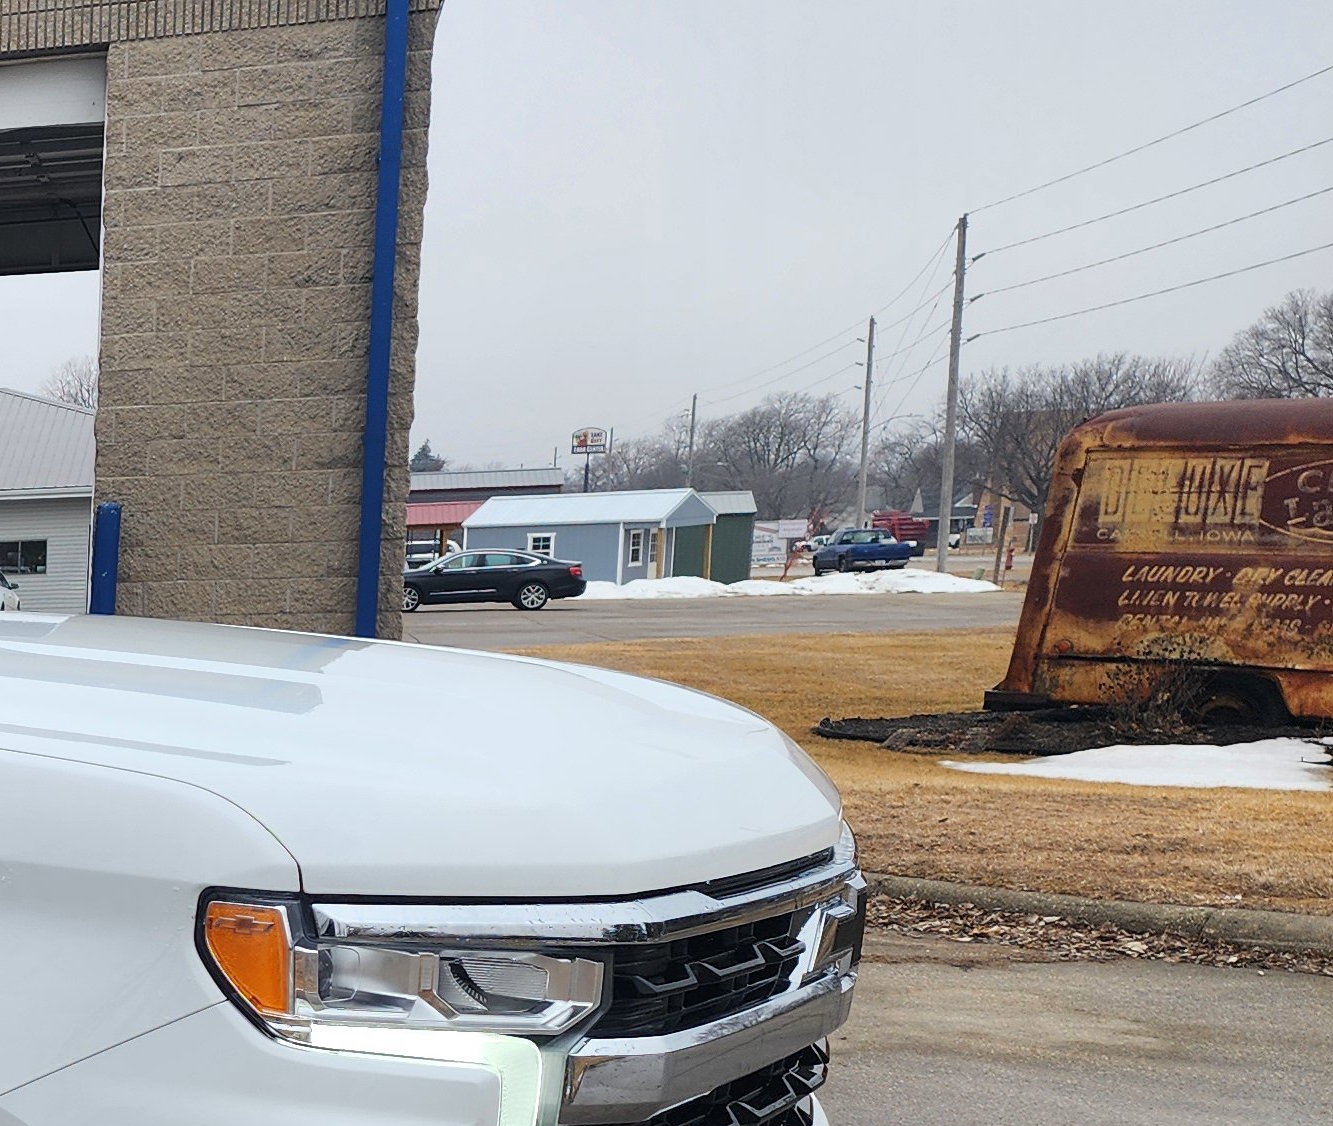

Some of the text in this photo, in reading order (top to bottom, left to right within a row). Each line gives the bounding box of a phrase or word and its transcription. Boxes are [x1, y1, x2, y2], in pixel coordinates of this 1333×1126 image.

[1199, 529, 1255, 542] IOWA
[1121, 565, 1224, 583] LAUNDRY
[1232, 566, 1284, 586] DRY
[1117, 589, 1181, 607] LINEN
